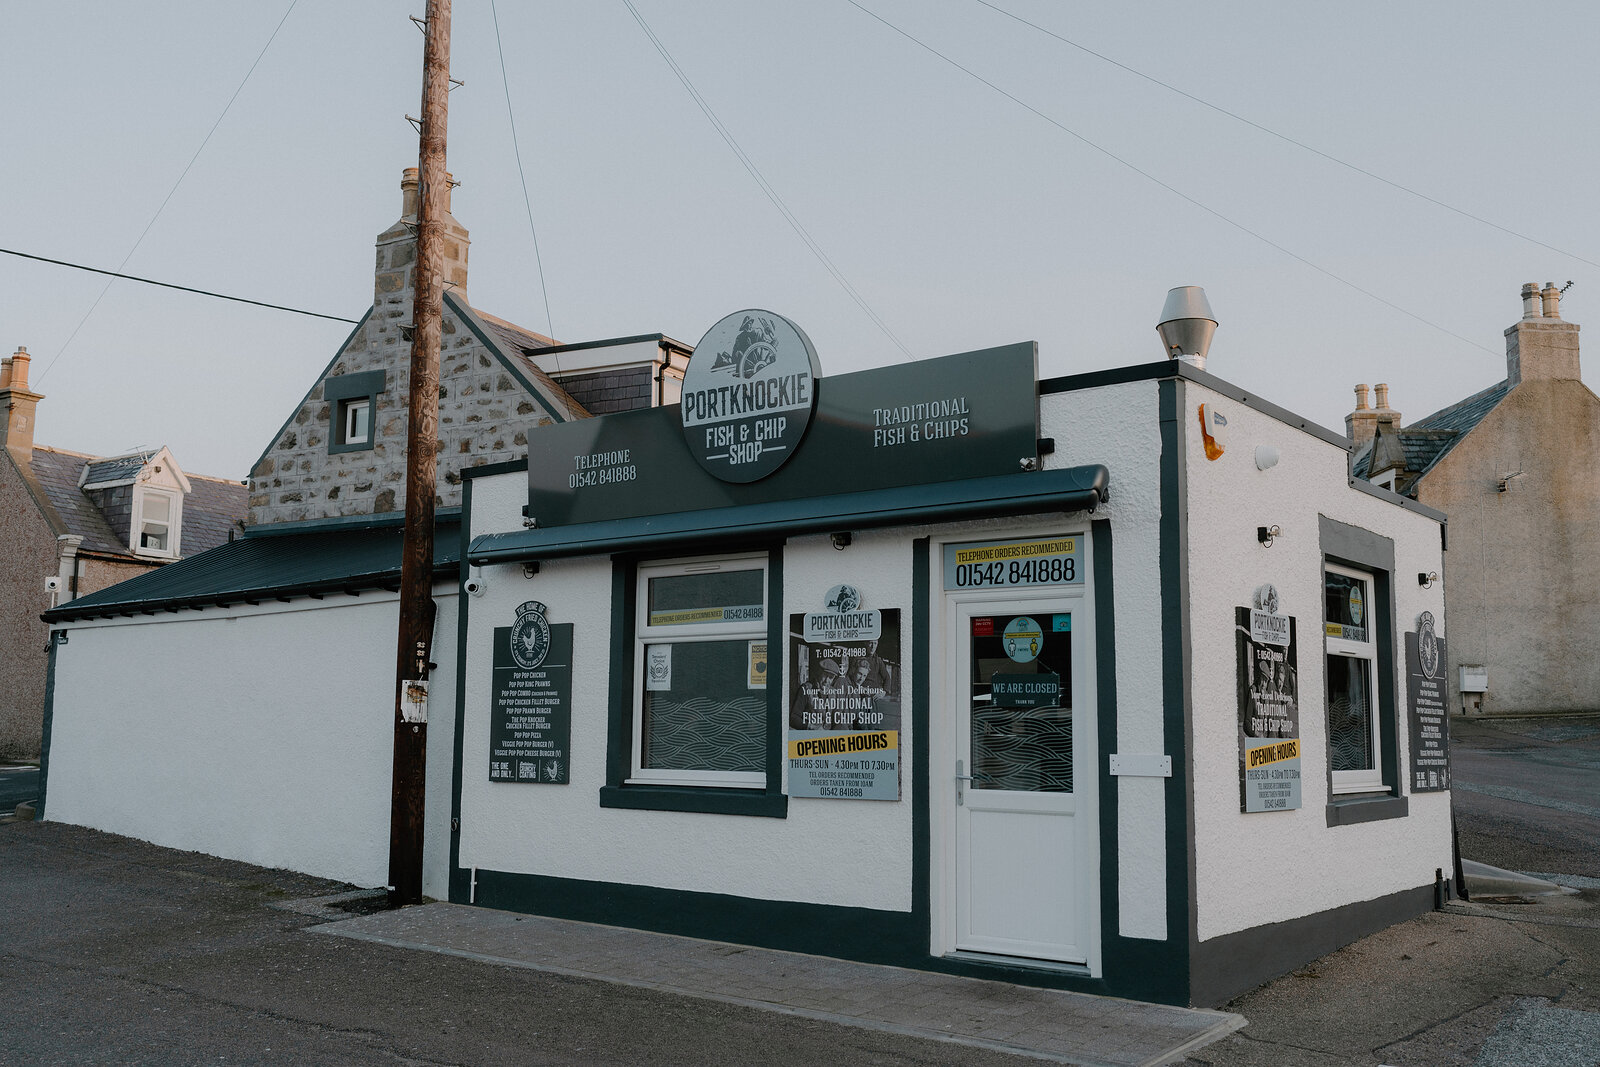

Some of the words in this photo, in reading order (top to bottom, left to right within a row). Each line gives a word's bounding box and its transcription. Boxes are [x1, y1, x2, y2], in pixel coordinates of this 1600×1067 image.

[685, 372, 808, 422] PORTKNOCKIE
[873, 397, 969, 426] TRADITIONAL
[706, 425, 734, 448] FISH
[740, 424, 749, 441] &
[755, 417, 786, 440] CHIP
[874, 427, 905, 447] FISH
[911, 424, 919, 442] &
[924, 418, 968, 440] CHIPS
[574, 449, 630, 470] TELEPHONE
[730, 442, 762, 464] SHOP
[569, 470, 596, 488] 01542
[600, 465, 636, 484] 841888
[958, 550, 993, 562] TELEPHONE
[995, 547, 1020, 558] ORDERS
[1021, 541, 1072, 556] RECOMMENDED
[956, 562, 1004, 586] 01542
[1009, 558, 1075, 584] 841888
[724, 610, 742, 619] 01542
[743, 608, 763, 618] 84188
[812, 613, 873, 630] PORTKNOCKIE
[1254, 613, 1286, 633] PORTKNOCKIE
[816, 650, 821, 658] T:
[823, 649, 840, 657] 01542
[843, 648, 866, 657] 841888
[802, 687, 819, 695] Your
[848, 685, 884, 695] Delicious
[993, 684, 1005, 693] WE
[1007, 683, 1023, 693] ARE
[1025, 683, 1056, 693] CLOSED
[813, 698, 872, 710] TRADITIONAL
[1257, 703, 1287, 716] TRADITIONAL
[802, 712, 822, 724] FISH
[826, 712, 831, 724] &
[834, 712, 856, 724] CHIP
[859, 712, 883, 724] SHOP
[1252, 717, 1263, 730] FISH
[1269, 718, 1279, 731] CHIP
[1281, 719, 1293, 732] SHOP
[797, 737, 845, 756] OPENING
[848, 733, 887, 751] HOURS
[1251, 746, 1276, 766] OPENING
[1277, 742, 1296, 760] HOURS
[861, 761, 870, 770] TO
[821, 788, 838, 796] 01542
[840, 788, 862, 797] 841888
